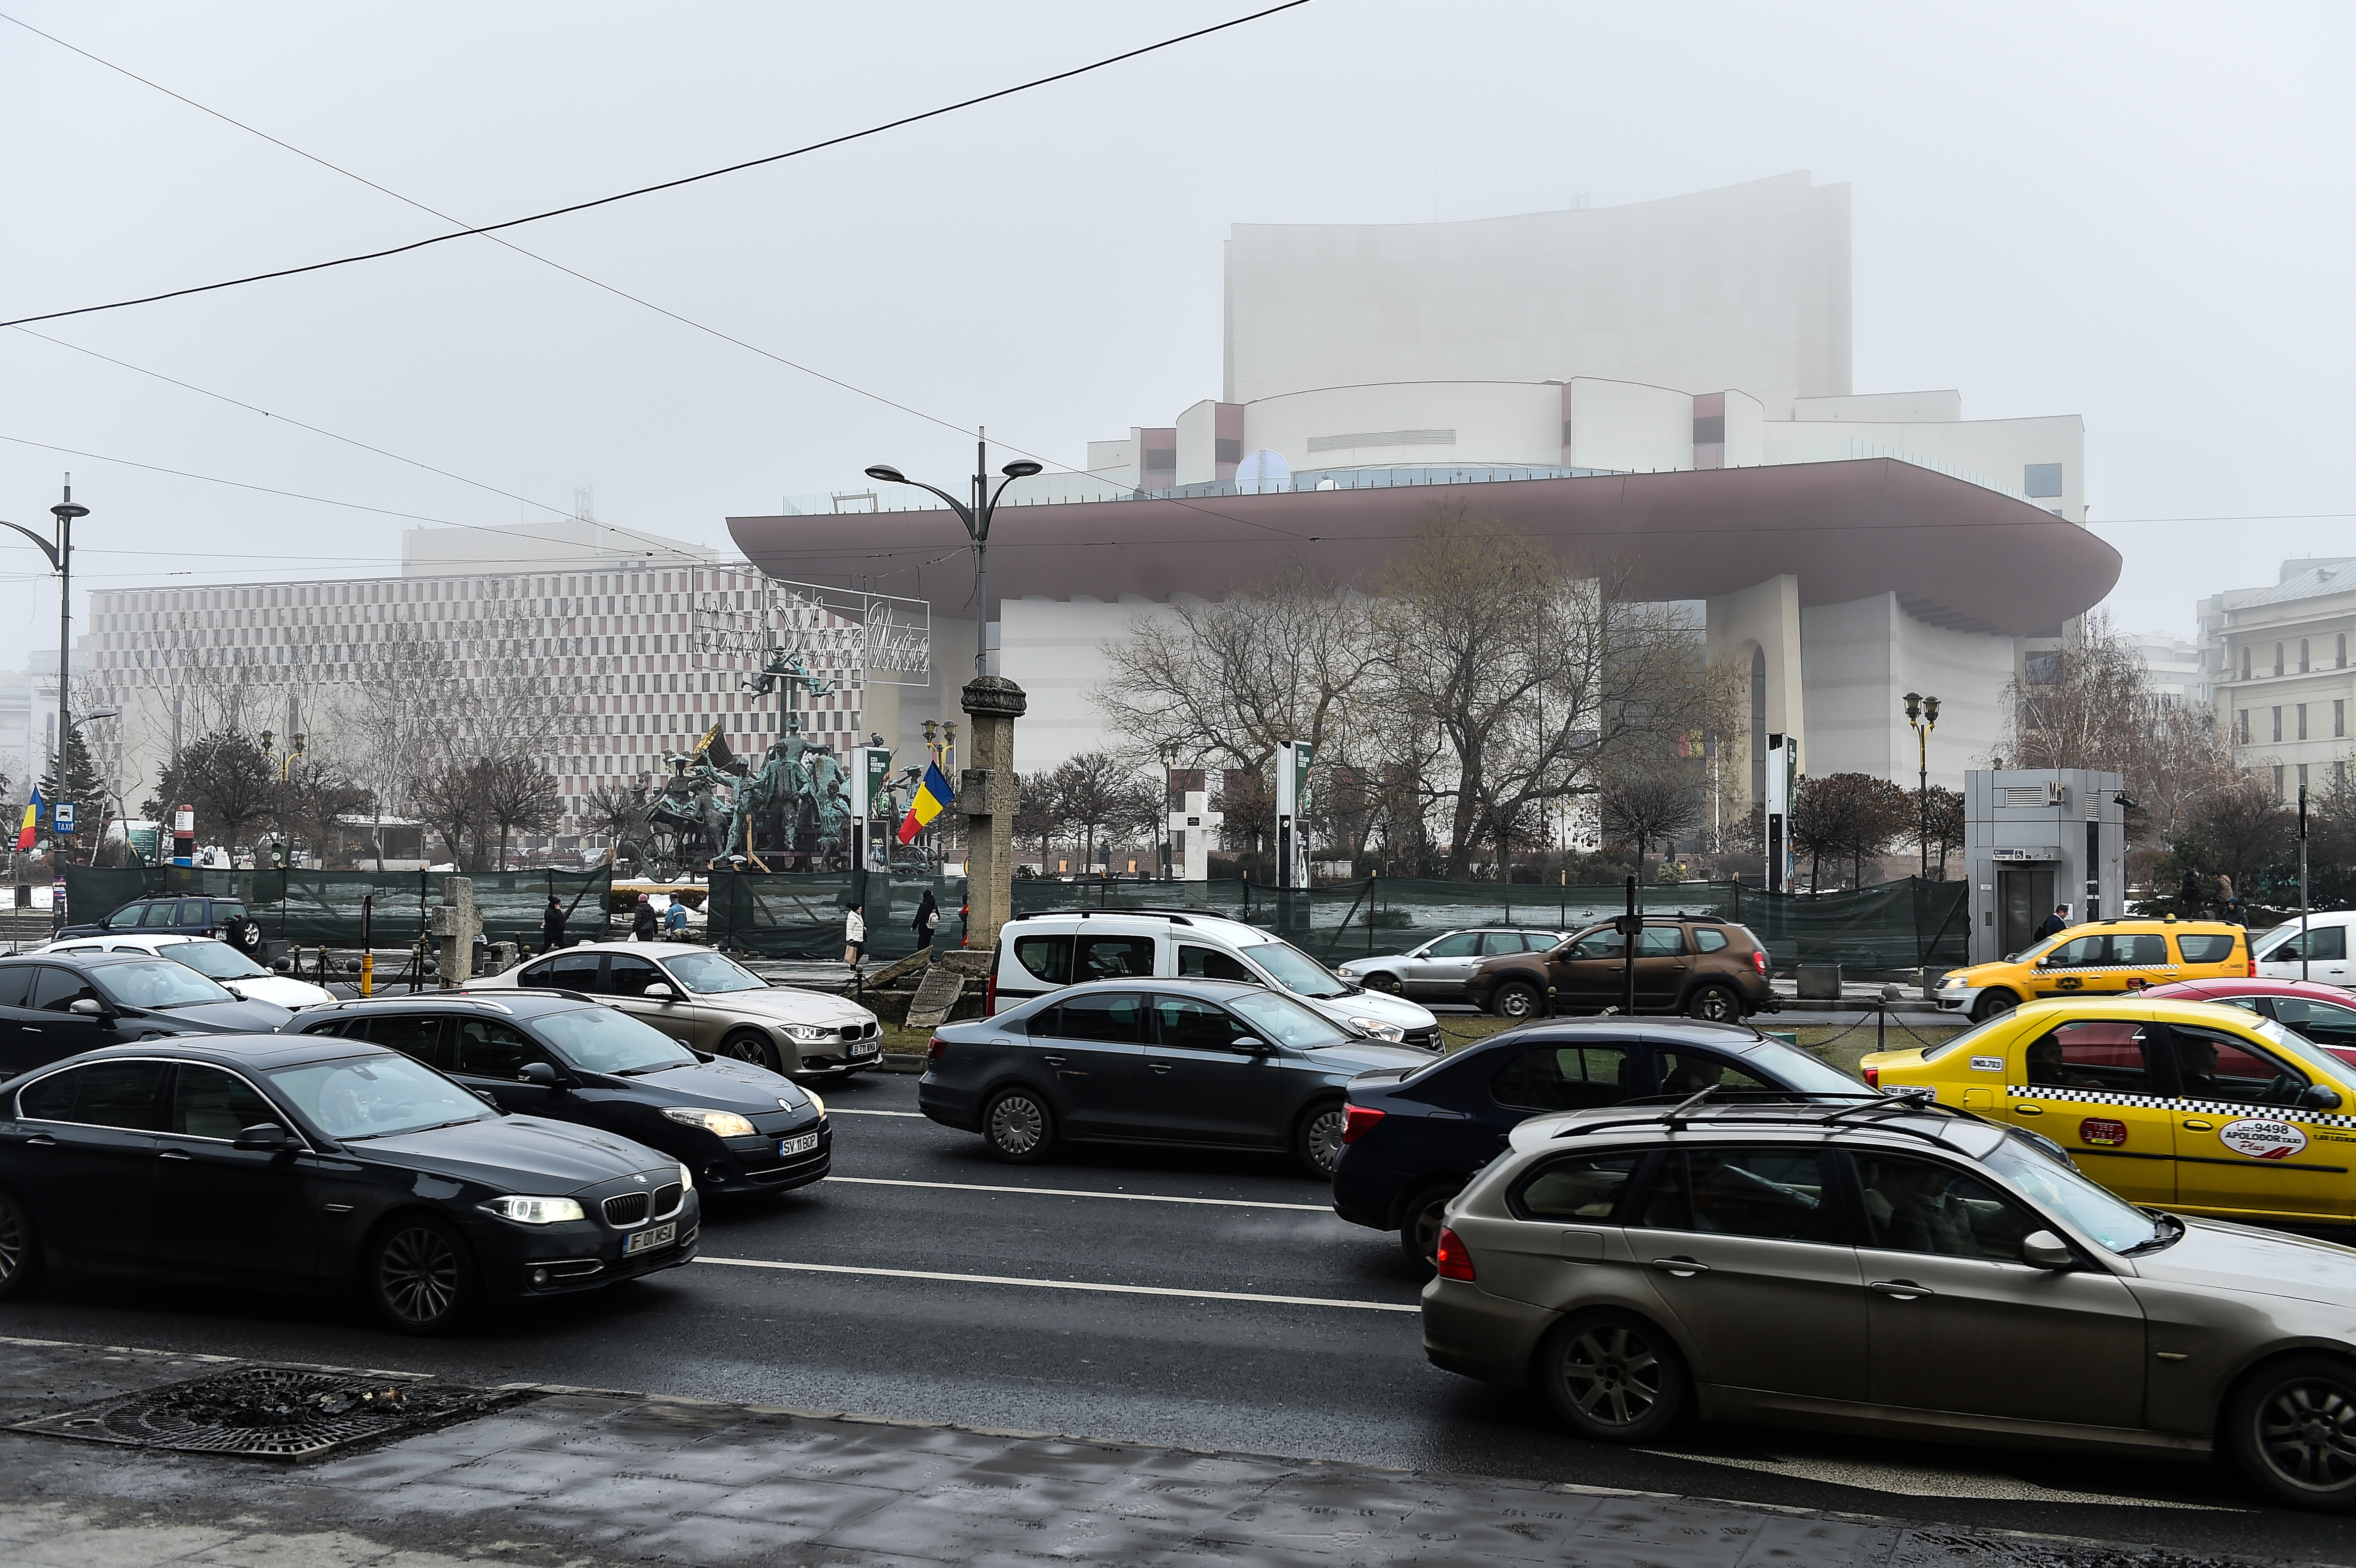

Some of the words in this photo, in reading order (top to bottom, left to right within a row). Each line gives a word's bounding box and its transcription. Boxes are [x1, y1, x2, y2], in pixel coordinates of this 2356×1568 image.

[2050, 782, 2056, 799] M
[58, 823, 71, 831] TAXI
[854, 1045, 858, 1054] B
[2255, 1123, 2289, 1135] 9498
[2225, 1131, 2281, 1142] APOLODOR
[783, 1140, 794, 1154] SV
[796, 1138, 802, 1151] 11
[803, 1135, 816, 1149] BOP
[2239, 1140, 2266, 1151] Plus
